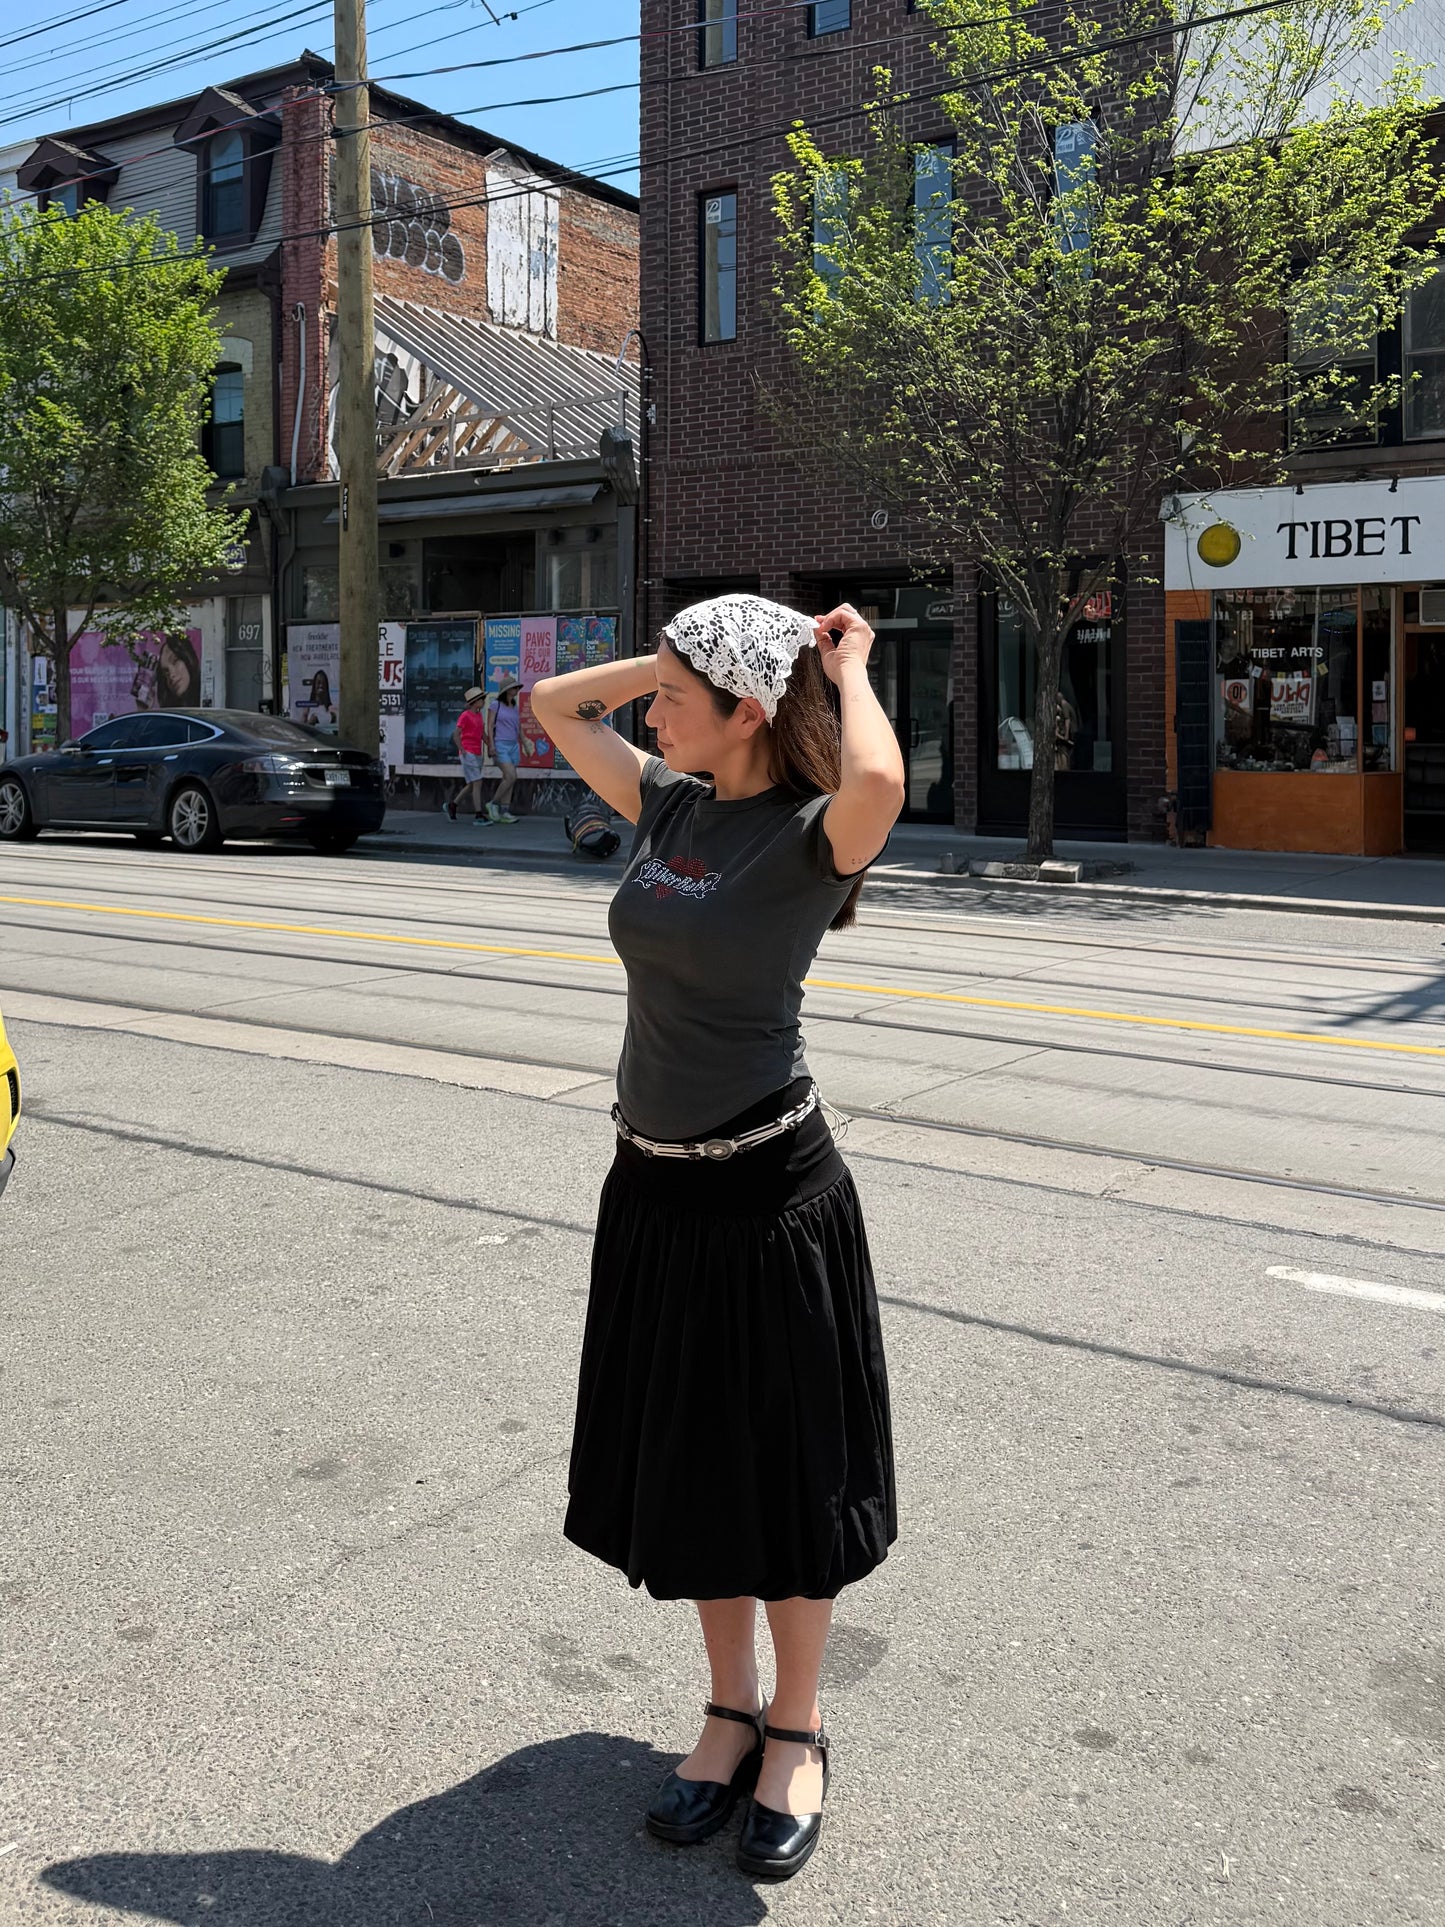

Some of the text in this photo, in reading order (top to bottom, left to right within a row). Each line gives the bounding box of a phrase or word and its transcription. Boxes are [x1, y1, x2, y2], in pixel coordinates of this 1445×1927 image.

[1276, 516, 1421, 559] TIBET
[238, 624, 260, 640] 697
[489, 624, 520, 638] MISSING
[525, 632, 552, 647] PAWS
[1251, 647, 1324, 658] TIBET ARTS
[524, 656, 551, 673] Pets
